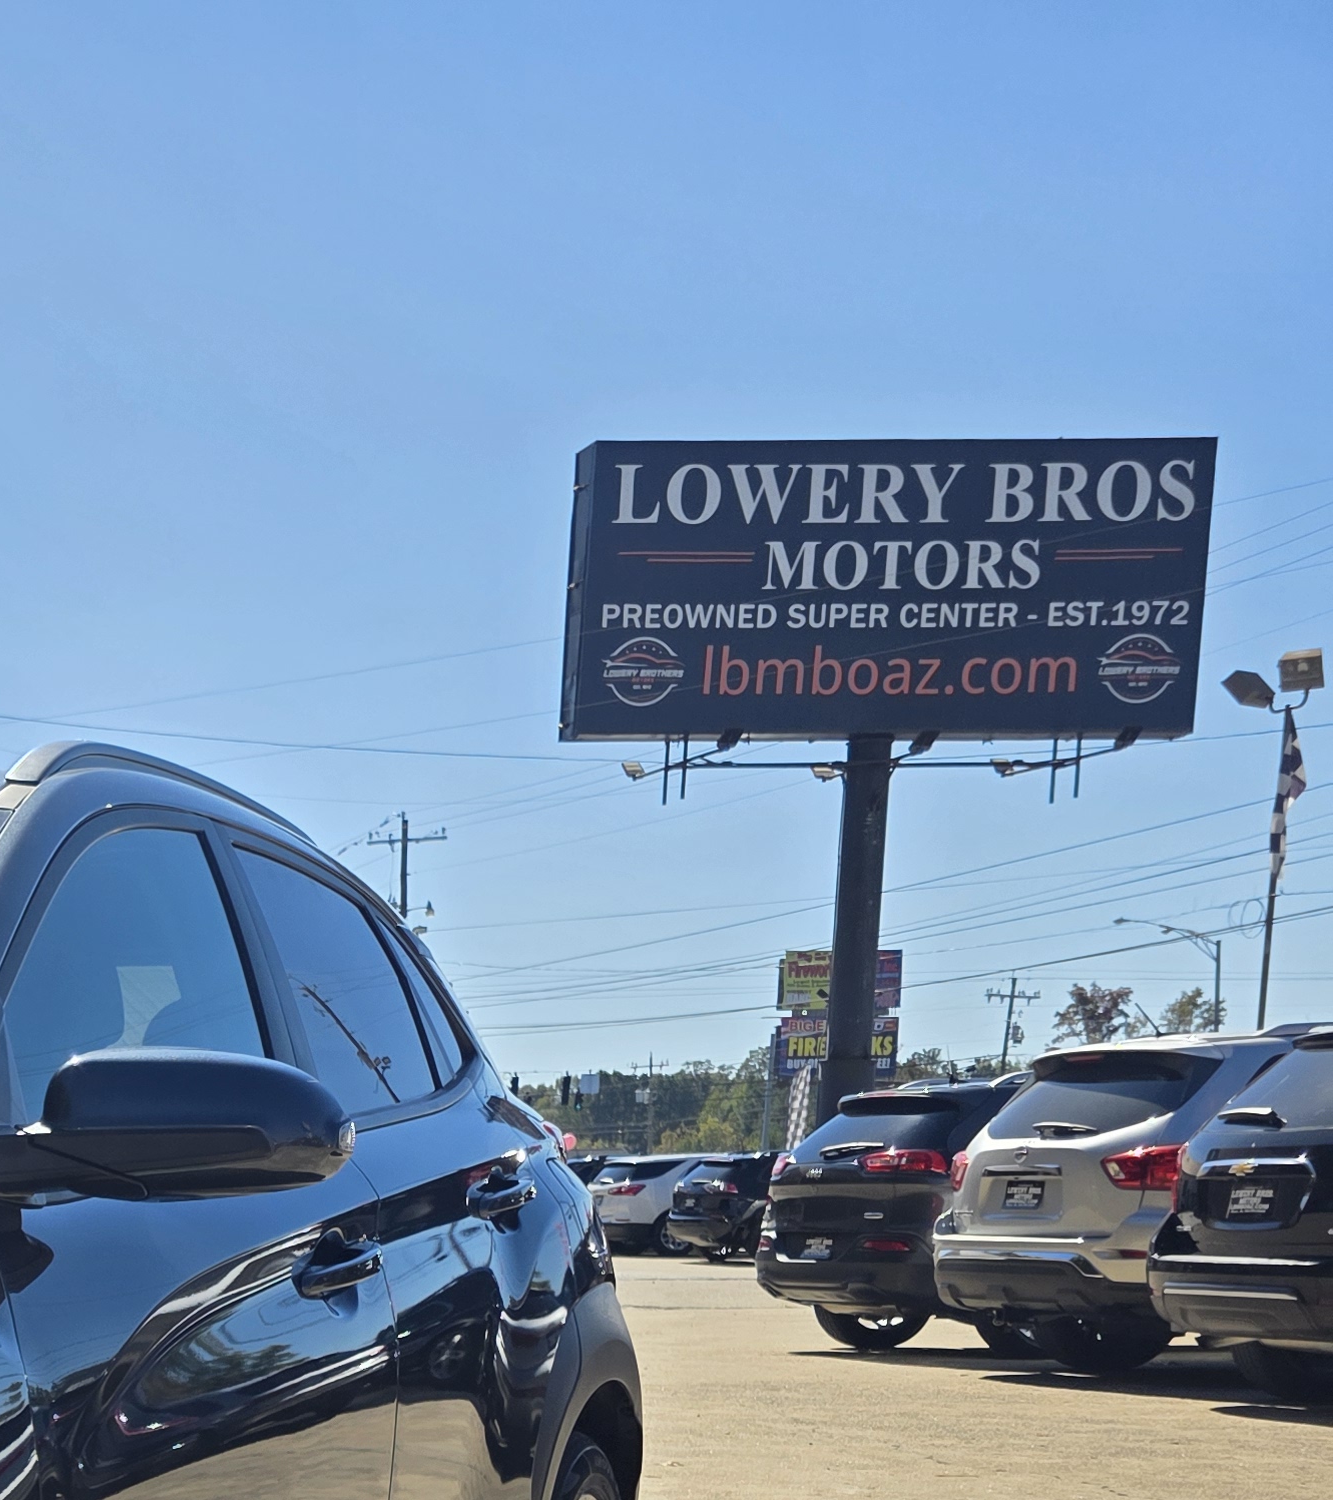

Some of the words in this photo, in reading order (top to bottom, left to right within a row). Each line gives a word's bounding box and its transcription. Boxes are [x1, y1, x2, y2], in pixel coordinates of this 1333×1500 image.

[612, 462, 967, 526] LOWERY
[984, 459, 1198, 524] BROS
[761, 537, 1042, 592] MOTORS
[600, 603, 778, 630] PREOWNED
[786, 602, 891, 629] SUPER
[899, 602, 1018, 629] CENTER
[1046, 600, 1191, 627] EST.1972
[701, 644, 1079, 697] lbmboaz.com
[789, 1020, 813, 1032] BIG
